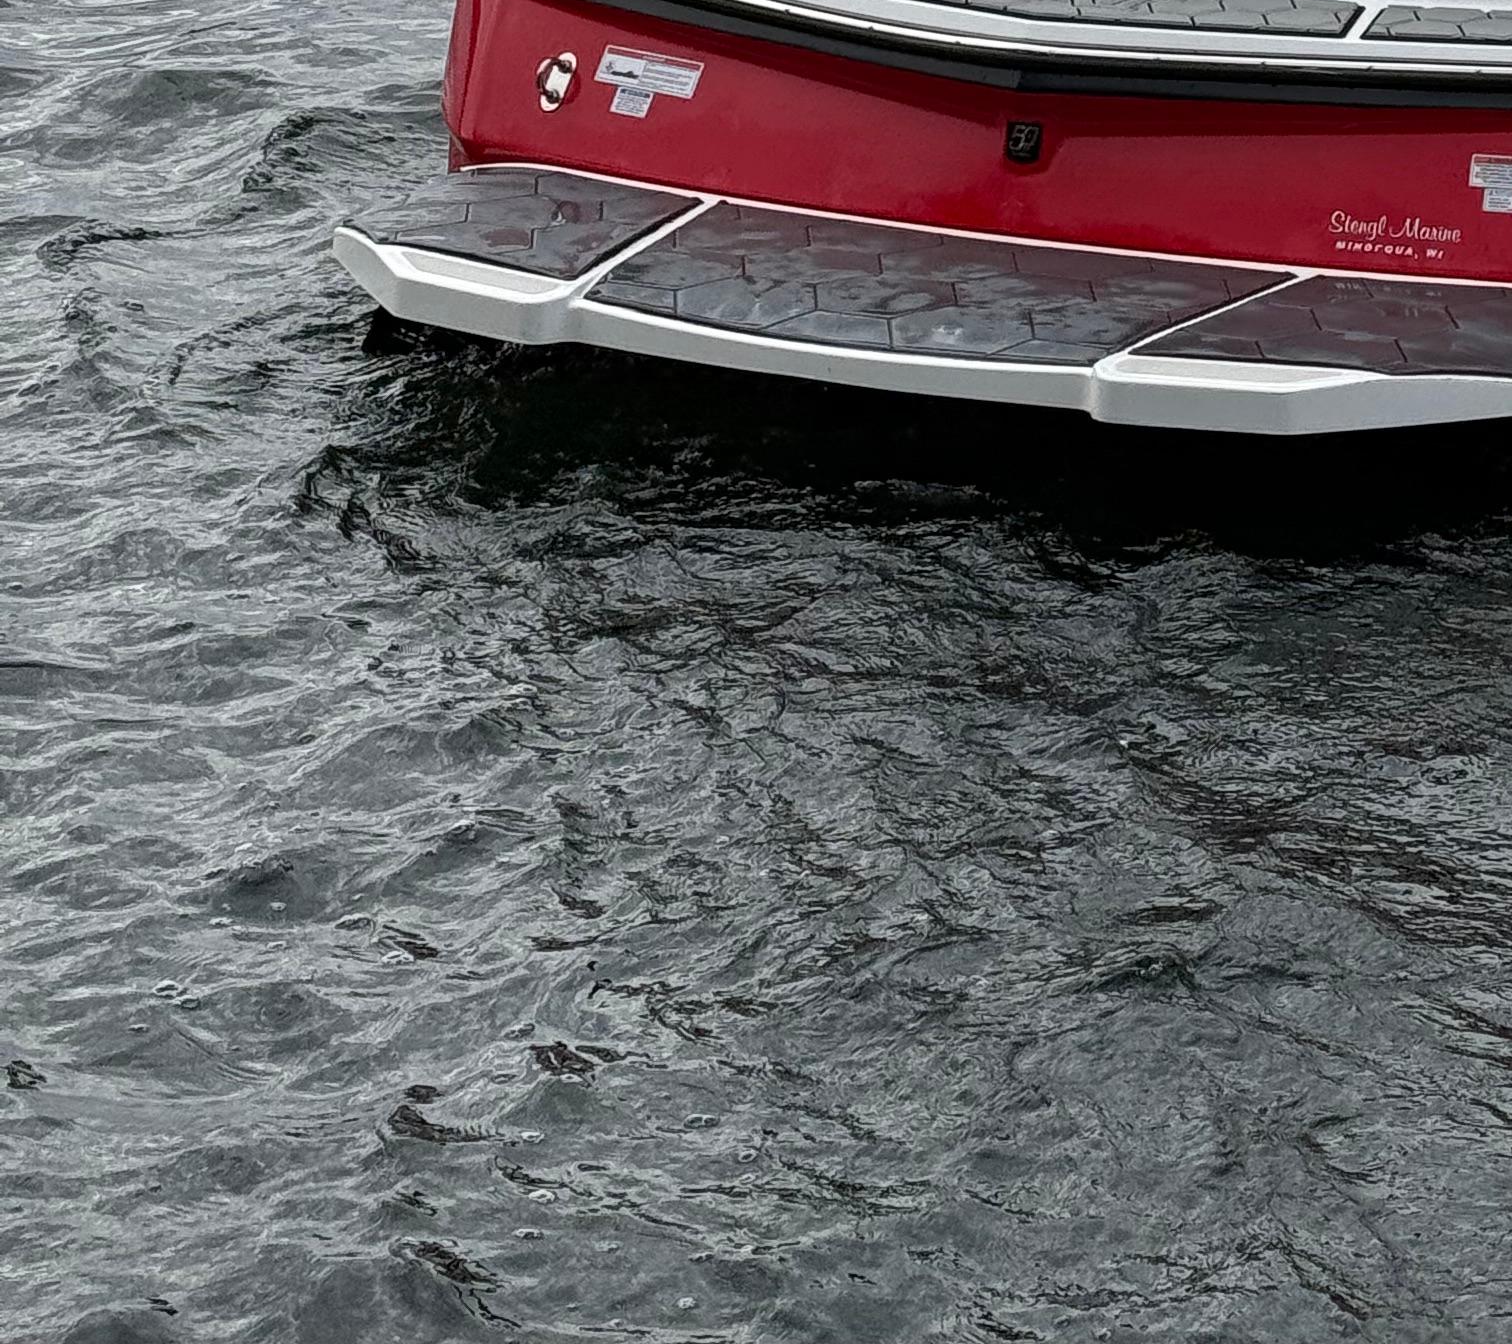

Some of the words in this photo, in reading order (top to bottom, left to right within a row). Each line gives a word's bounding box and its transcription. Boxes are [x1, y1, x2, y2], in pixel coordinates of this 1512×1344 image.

[1328, 210, 1388, 241] Stengl
[1389, 217, 1461, 243] Marine
[1426, 248, 1444, 259] WI
